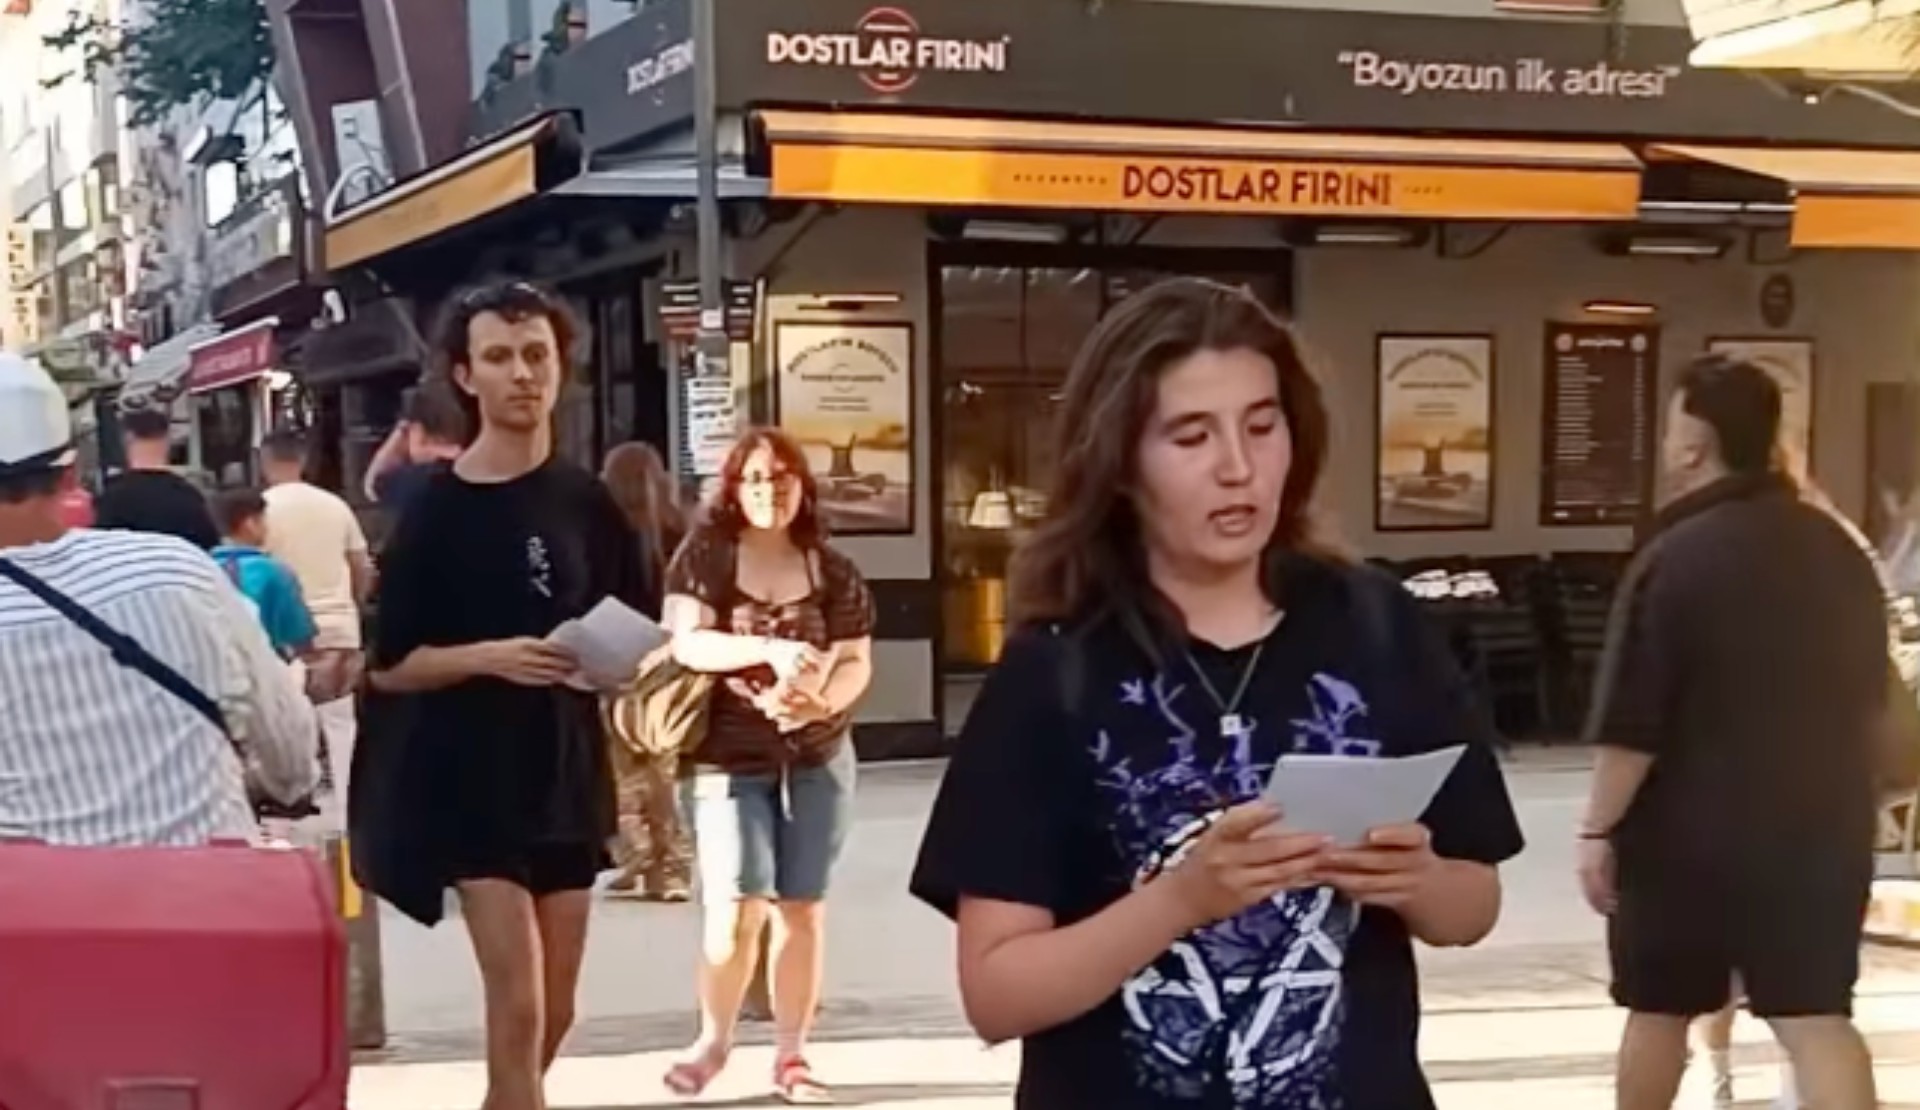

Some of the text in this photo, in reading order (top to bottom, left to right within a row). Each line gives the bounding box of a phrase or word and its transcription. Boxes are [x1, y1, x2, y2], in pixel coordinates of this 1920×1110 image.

[767, 33, 908, 67] DOSTLAR
[1516, 57, 1555, 92] ilk
[1122, 165, 1392, 206] DOSTLAR FIRINI
